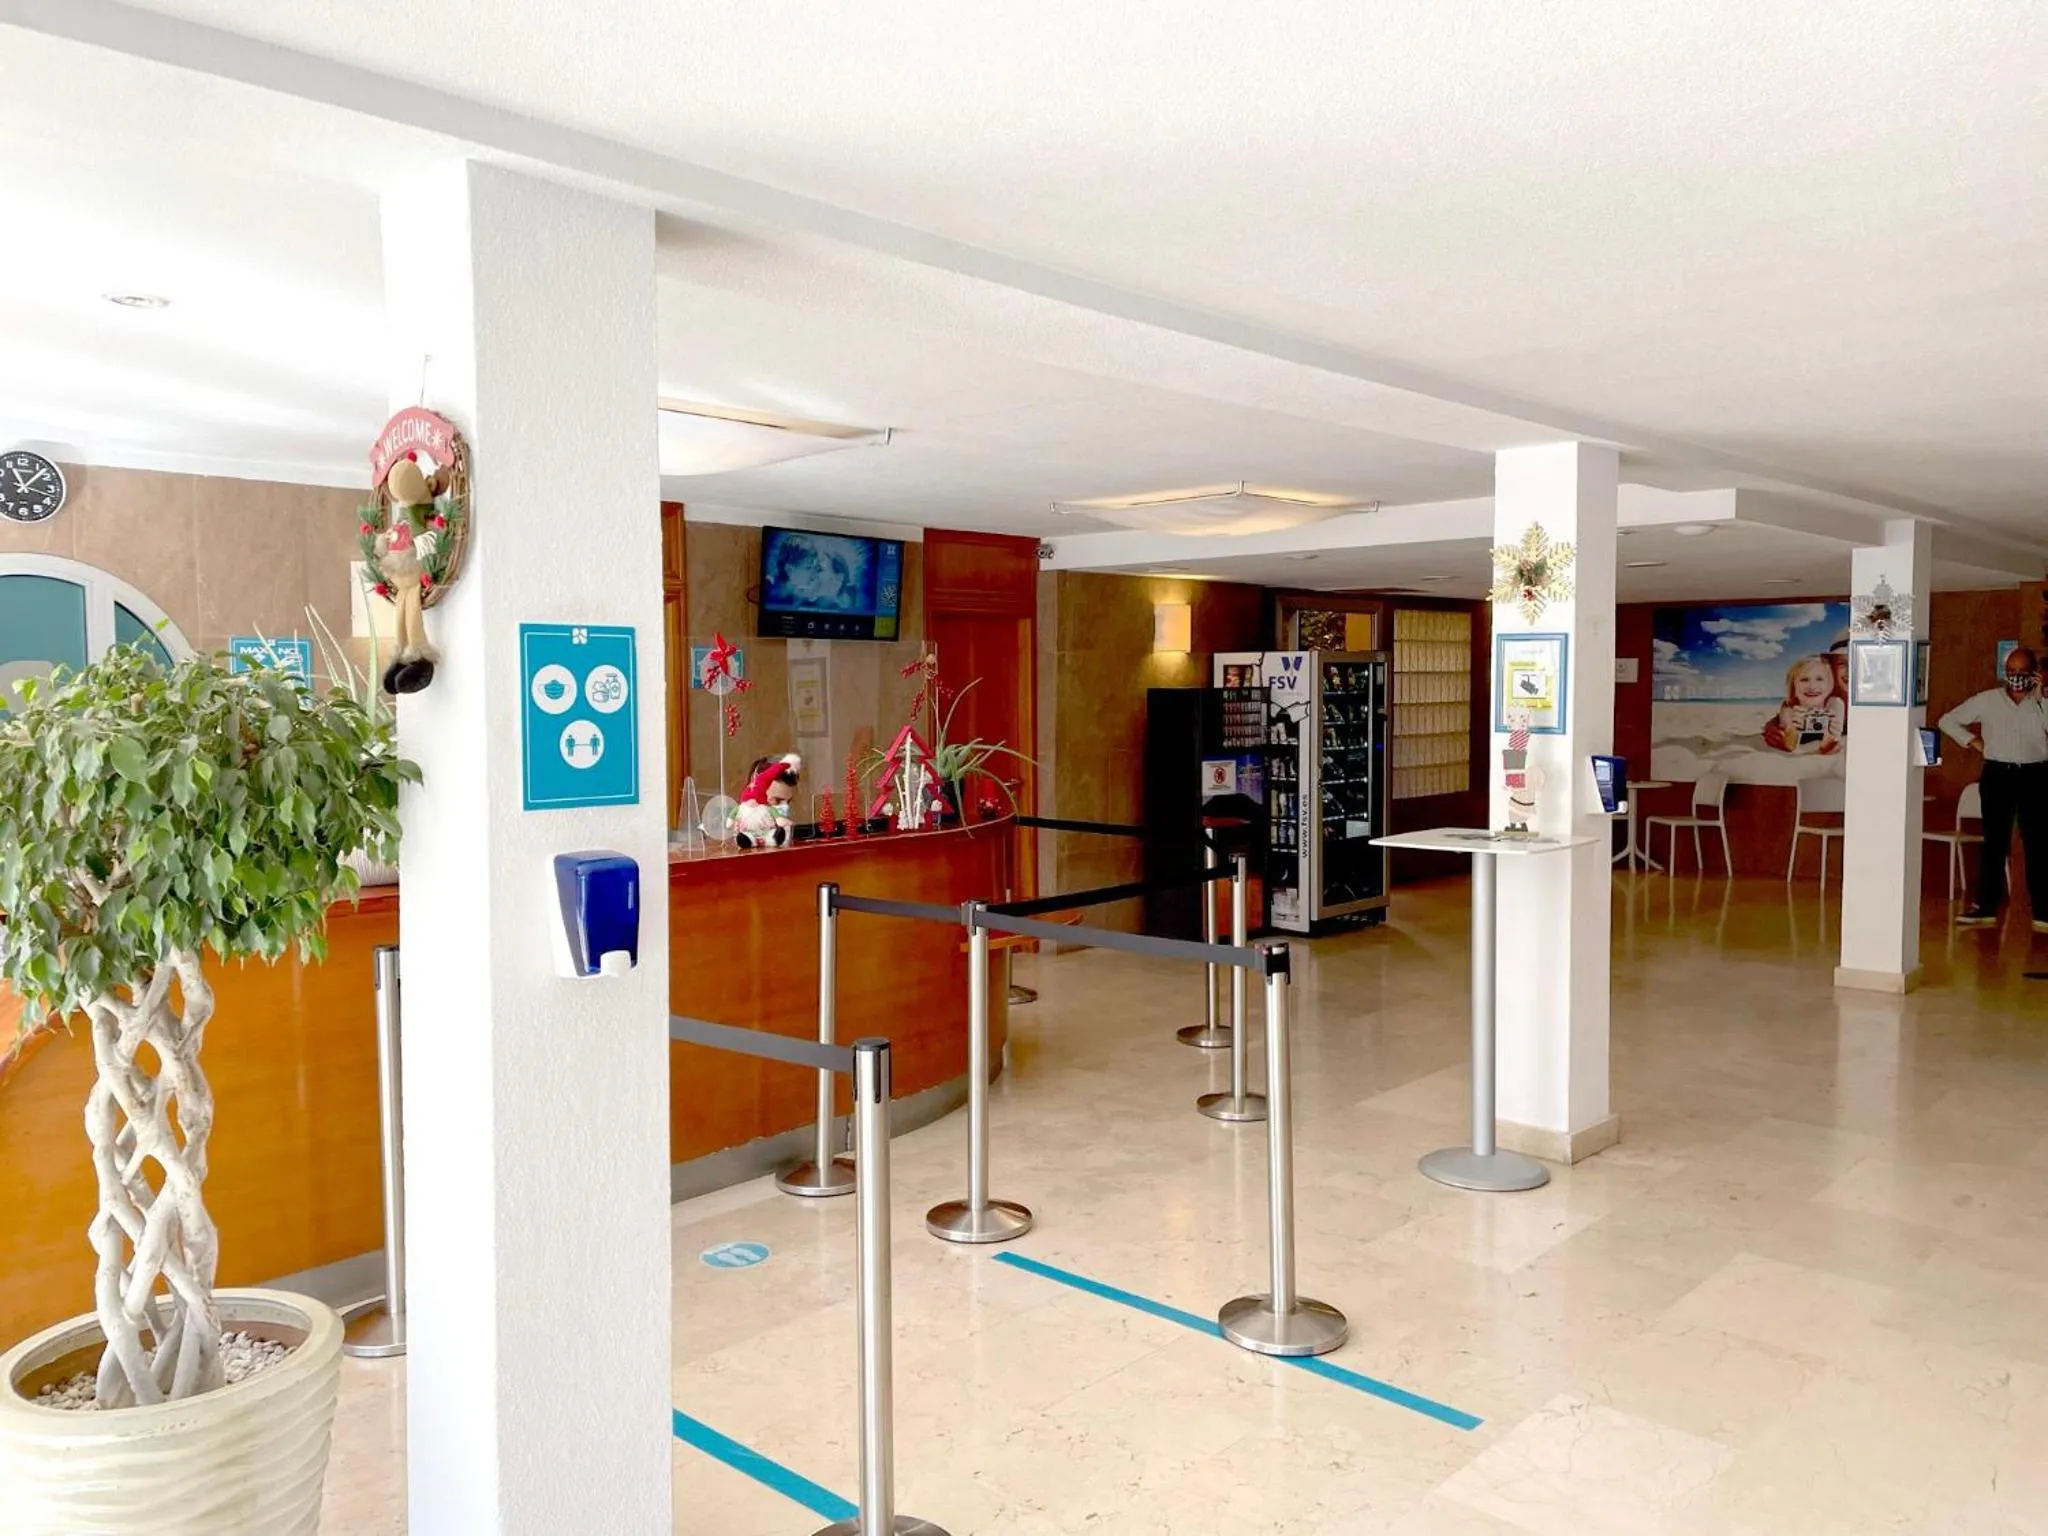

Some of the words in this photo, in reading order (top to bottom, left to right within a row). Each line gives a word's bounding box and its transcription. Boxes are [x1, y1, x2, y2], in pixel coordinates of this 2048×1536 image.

[383, 417, 432, 457] WELCOME
[17, 458, 29, 467] 12
[41, 473, 52, 481] 2
[46, 485, 55, 494] 3
[42, 497, 52, 506] 4
[5, 502, 15, 511] 7
[33, 504, 43, 513] 5
[18, 507, 29, 516] 6
[1268, 675, 1297, 690] FSV
